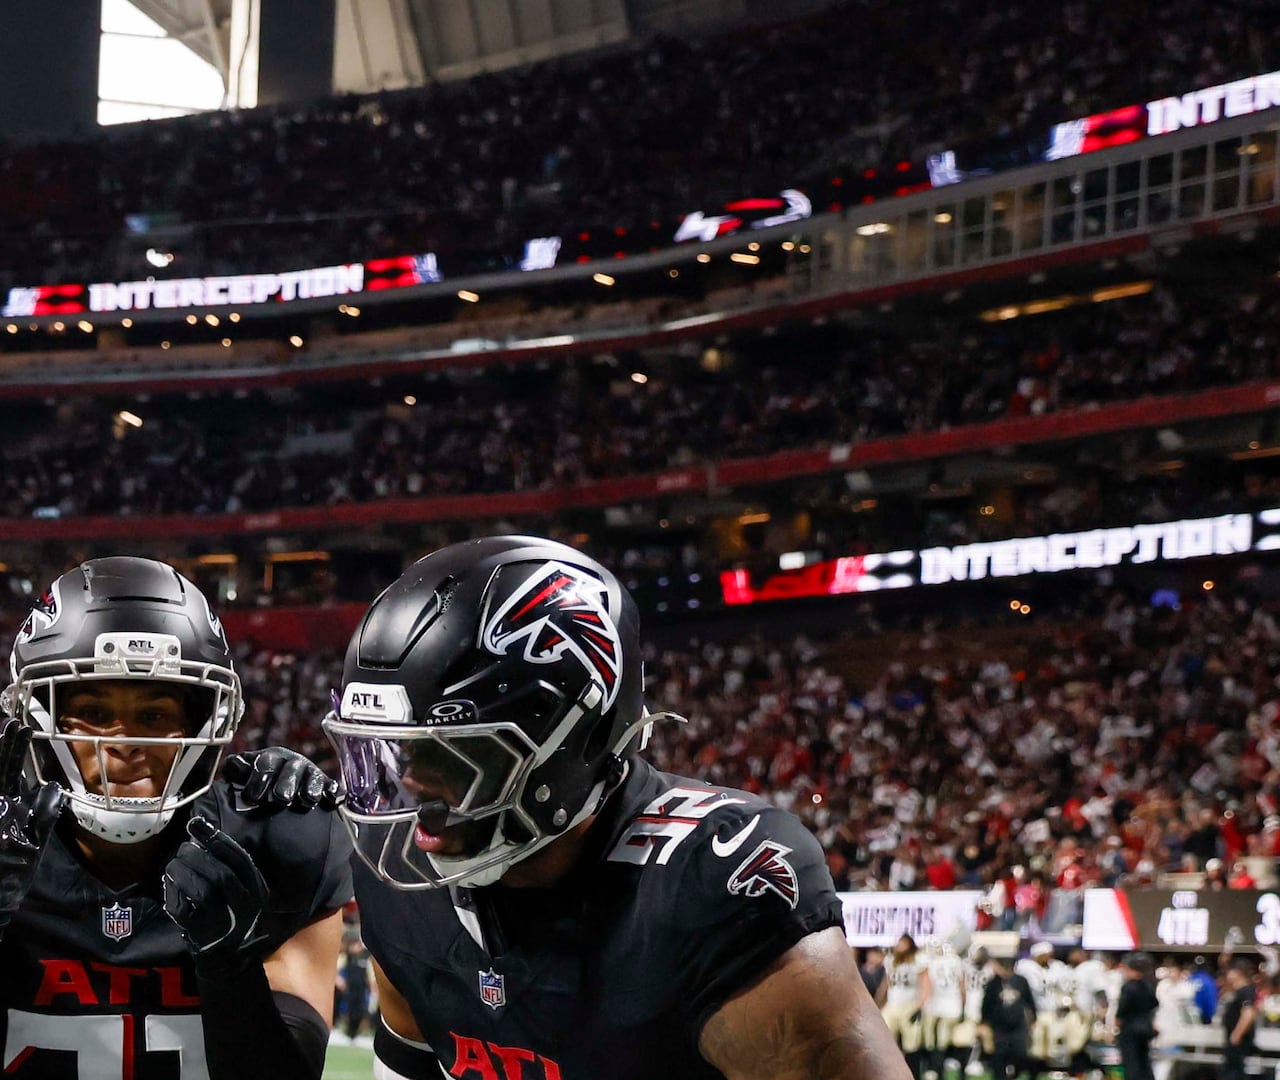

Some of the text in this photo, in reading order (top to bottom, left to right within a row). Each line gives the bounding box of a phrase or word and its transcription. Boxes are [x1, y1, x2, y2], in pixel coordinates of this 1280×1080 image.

[89, 263, 365, 311] INTERCEPTION
[920, 513, 1252, 584] INTERCEPTION
[128, 639, 155, 649] ATL
[351, 692, 383, 708] ATL
[426, 711, 473, 726] OAKLEY
[33, 959, 201, 1007] ATL
